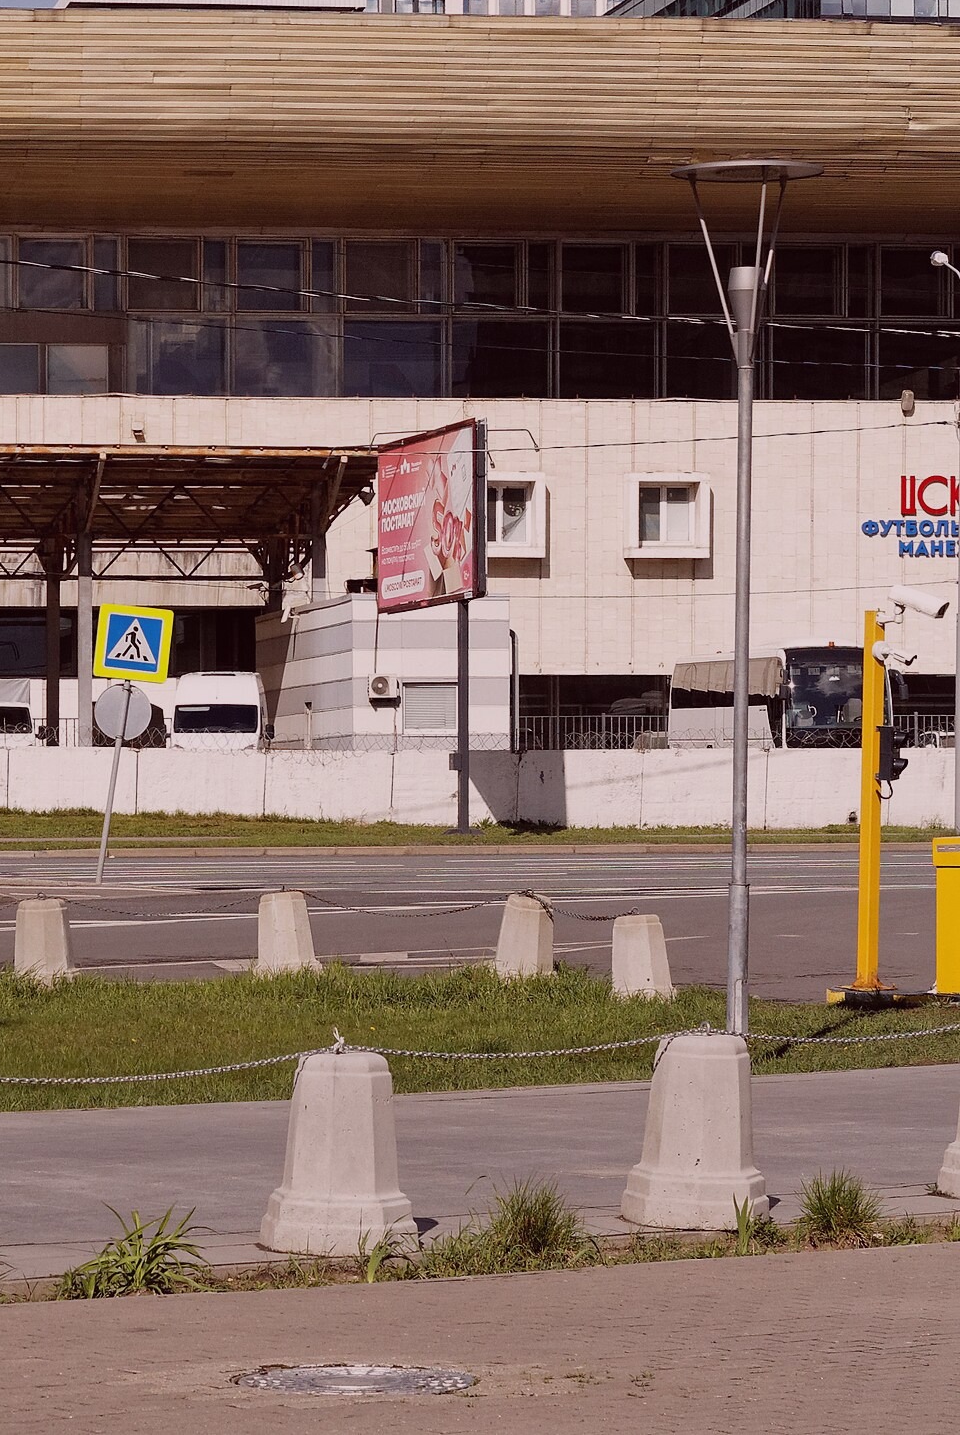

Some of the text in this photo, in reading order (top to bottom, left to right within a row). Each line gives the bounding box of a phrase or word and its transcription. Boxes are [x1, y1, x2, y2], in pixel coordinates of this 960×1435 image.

[381, 487, 425, 516] МОСКОВСКИЙ
[381, 511, 415, 533] ПОСТАМАТ
[898, 540, 959, 558] МАНЕ
